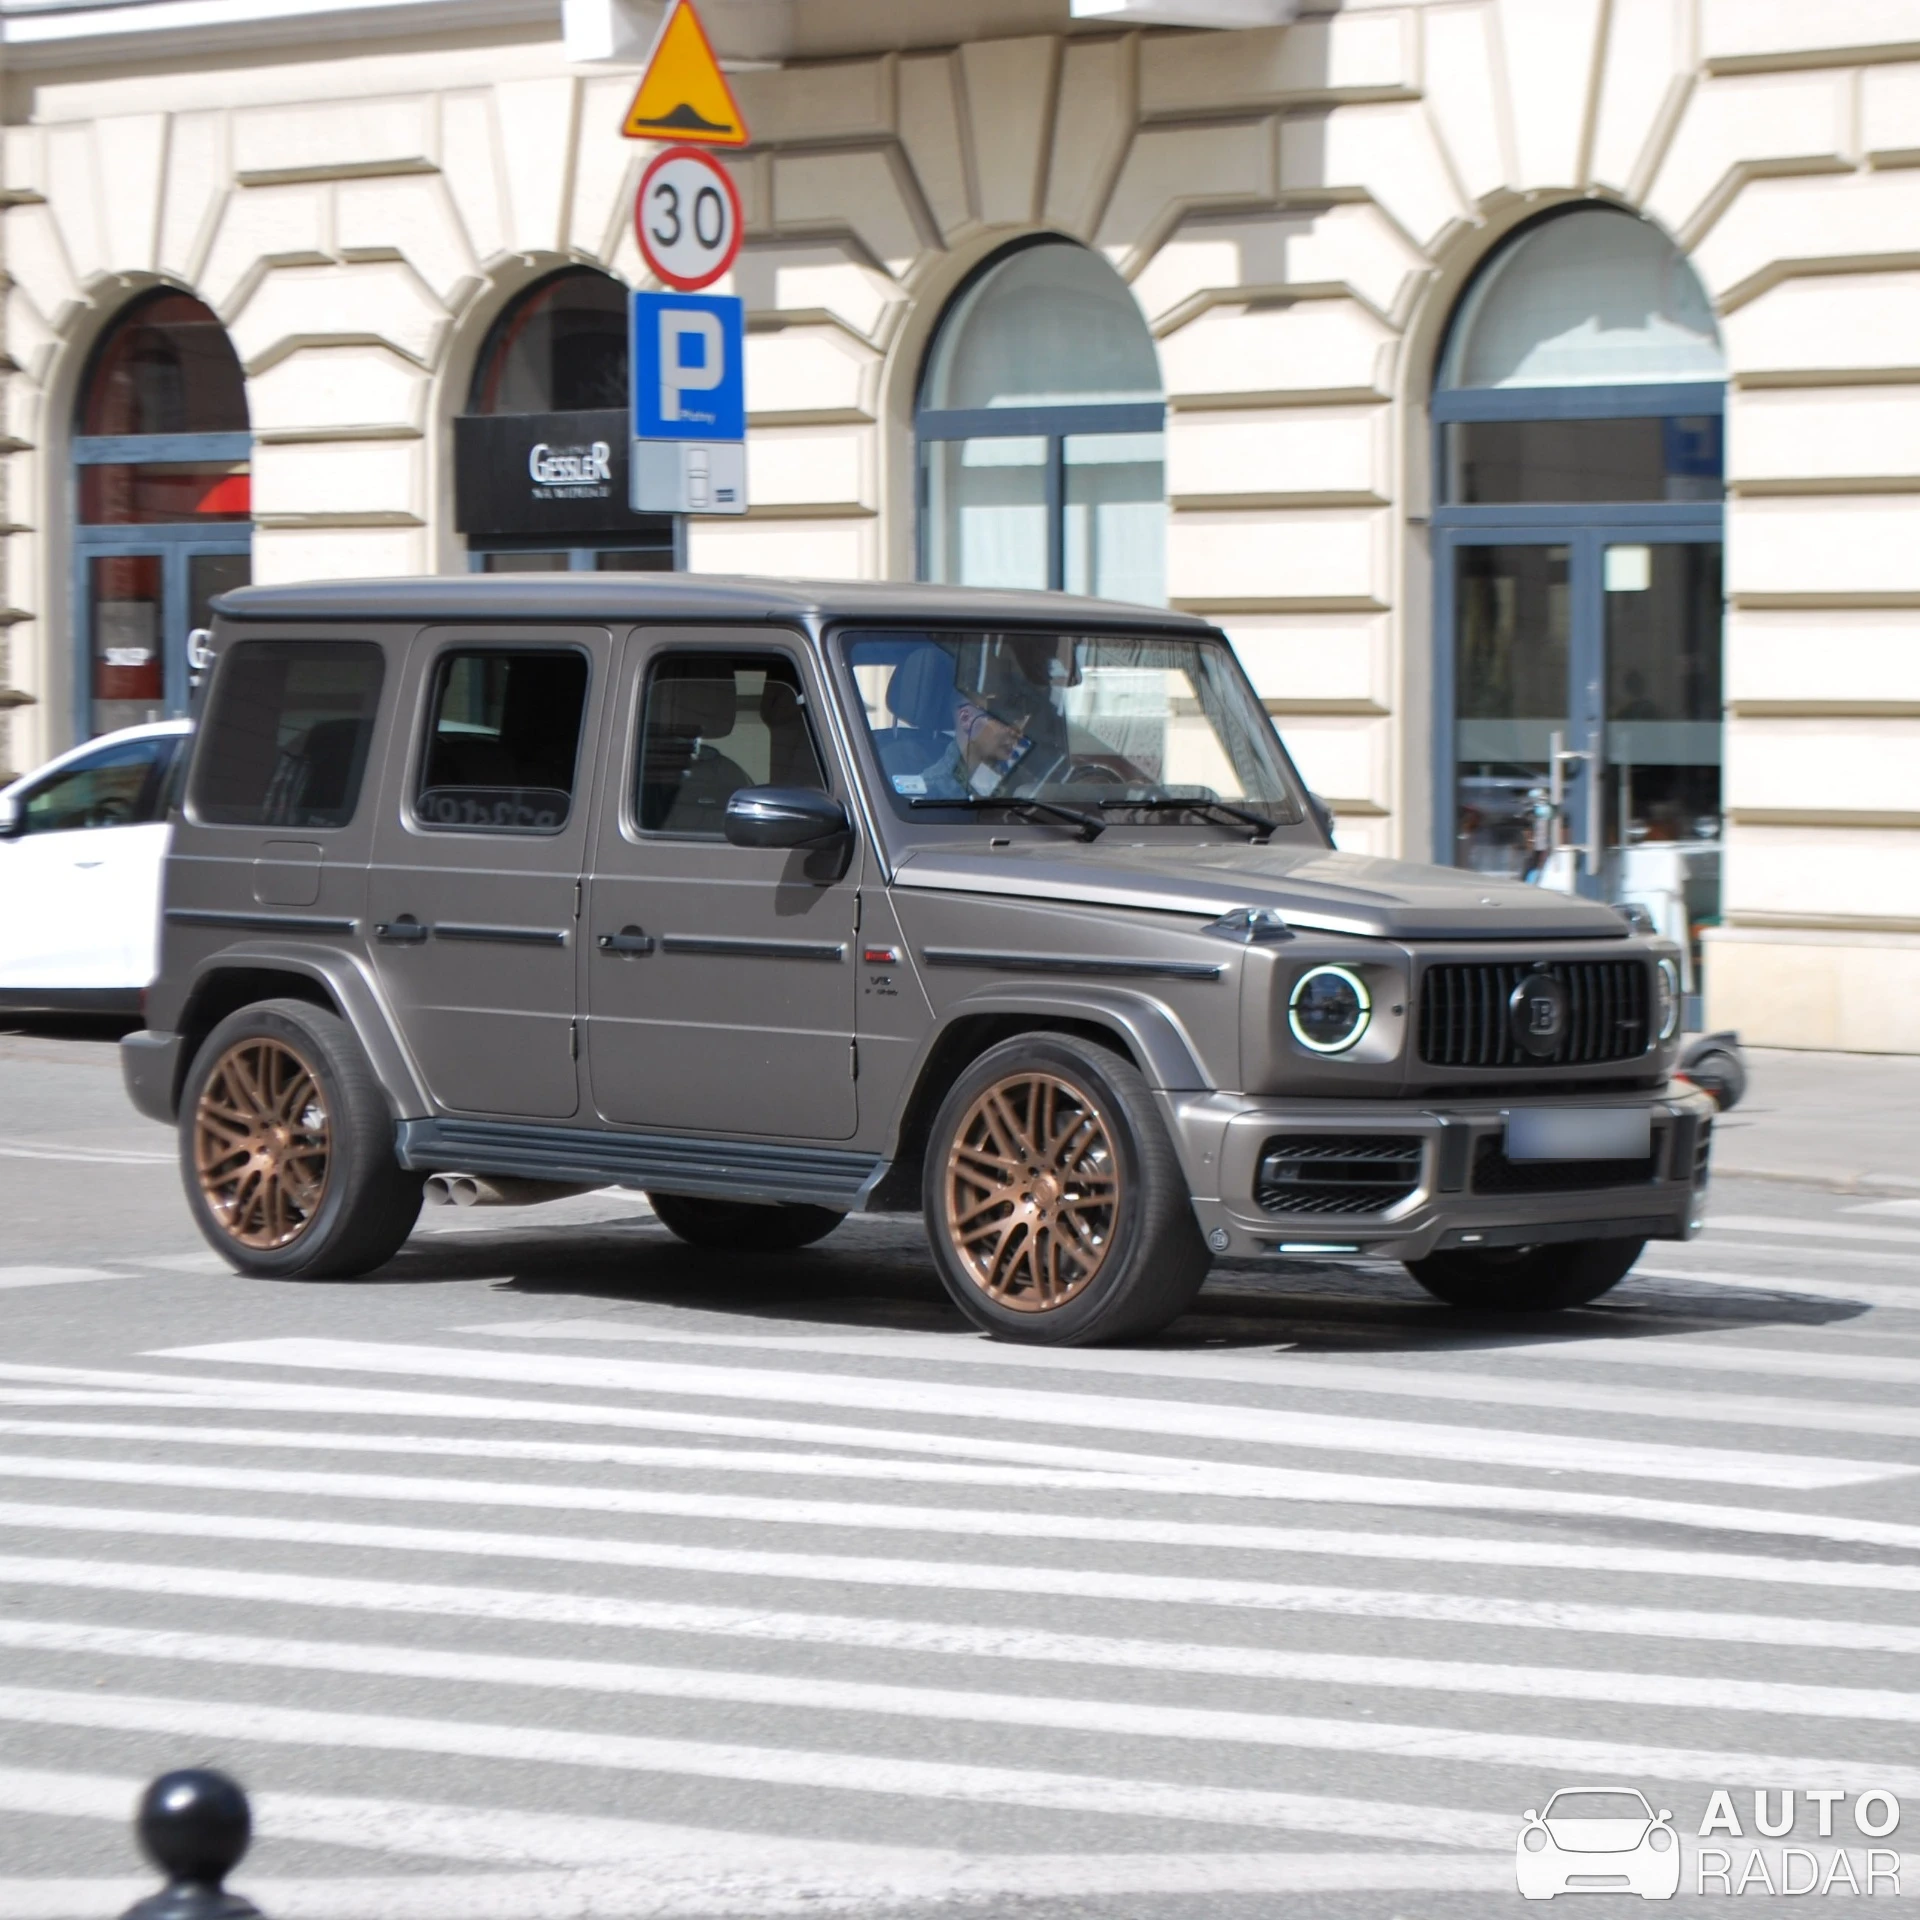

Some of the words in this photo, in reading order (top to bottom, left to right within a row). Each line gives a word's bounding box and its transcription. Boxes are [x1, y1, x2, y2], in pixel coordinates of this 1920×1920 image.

[653, 183, 724, 250] 30
[658, 308, 725, 421] P
[1529, 998, 1561, 1035] B
